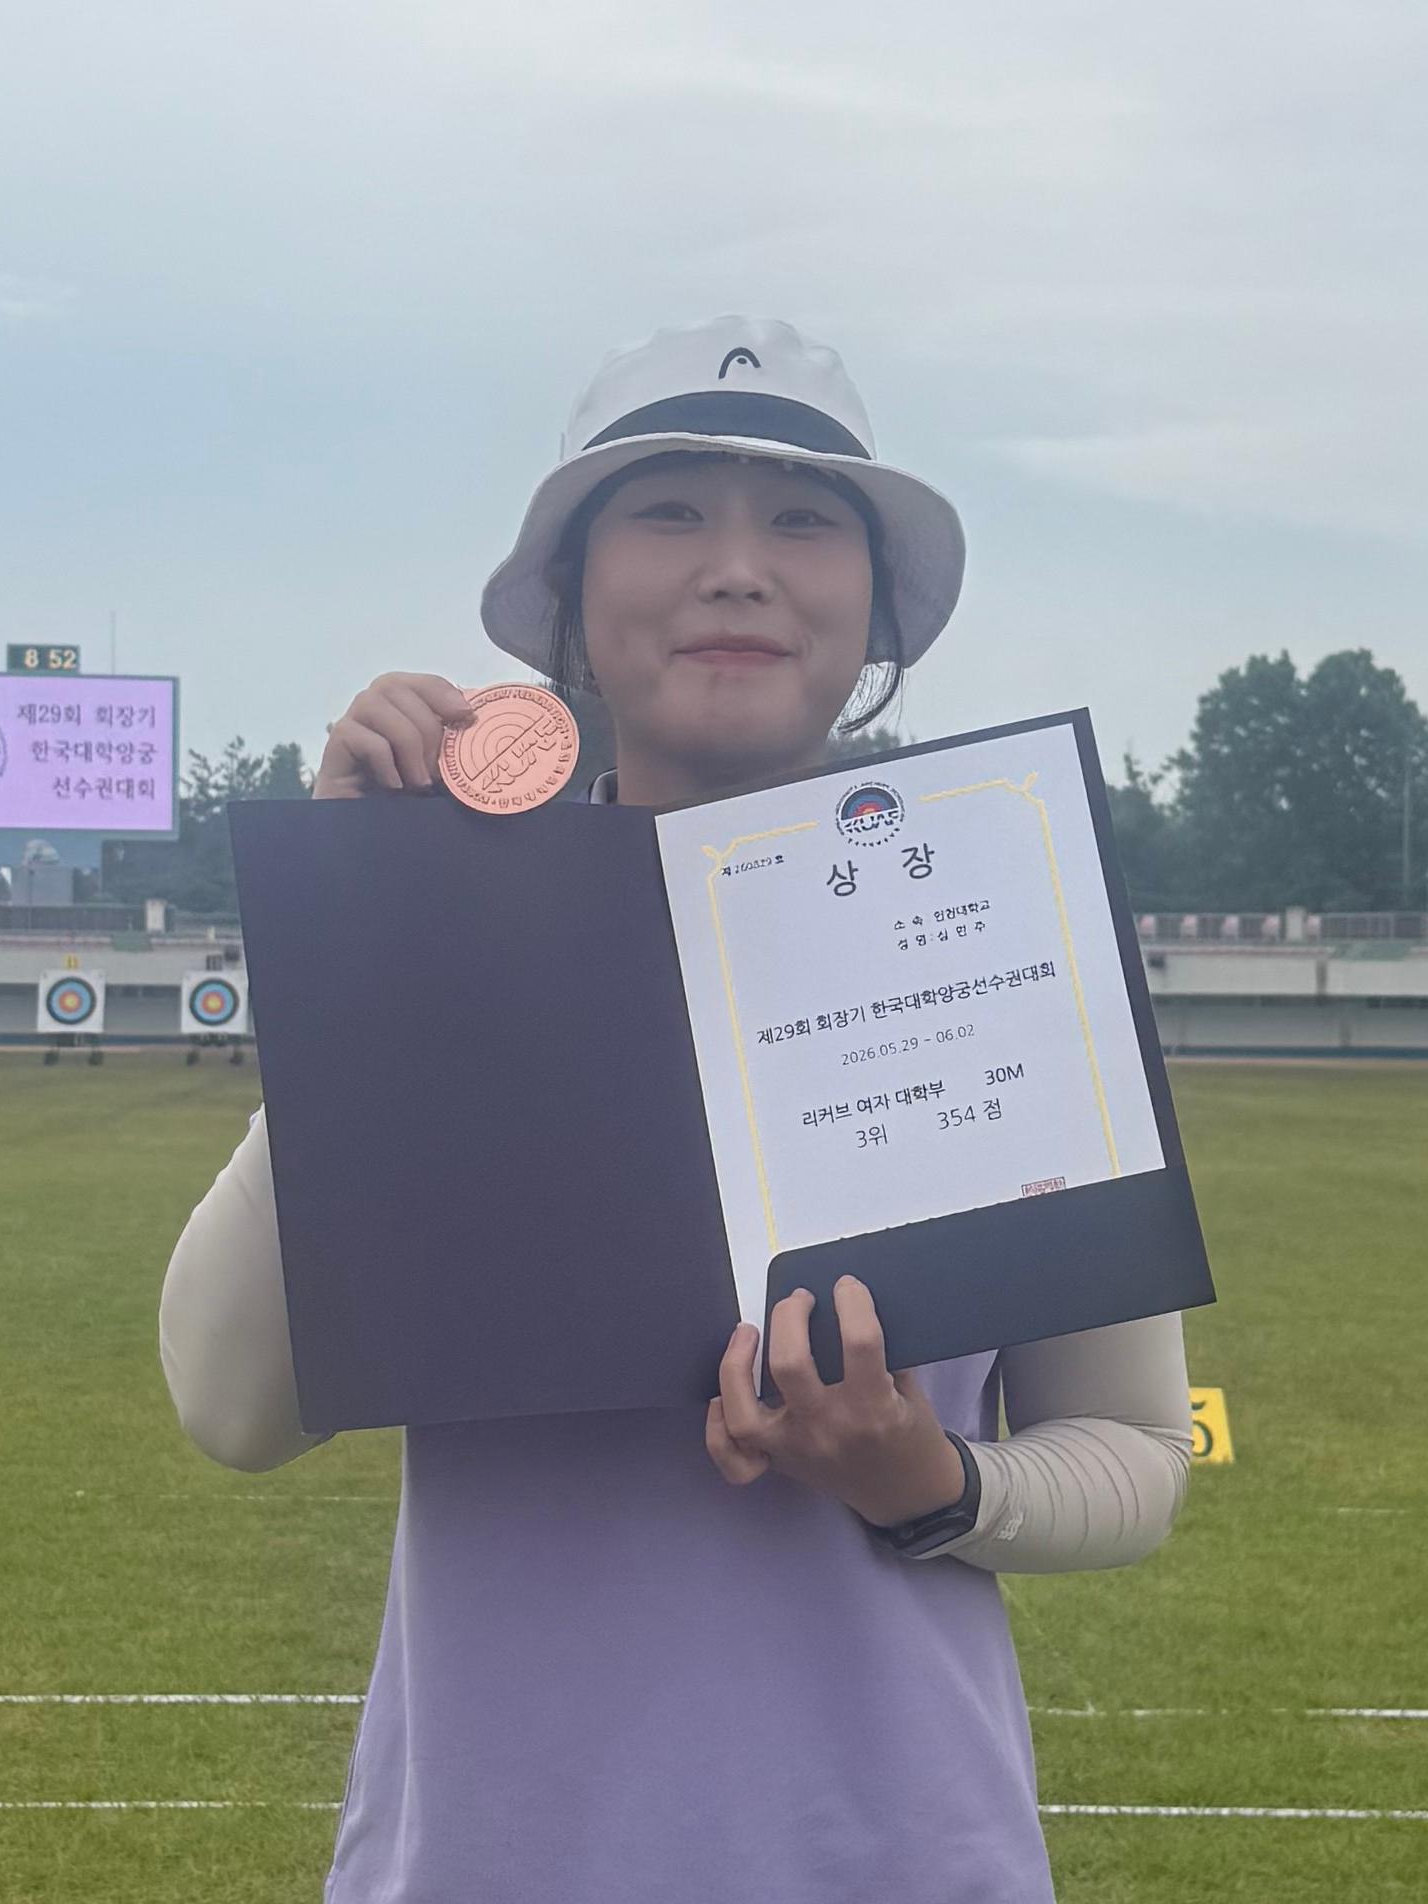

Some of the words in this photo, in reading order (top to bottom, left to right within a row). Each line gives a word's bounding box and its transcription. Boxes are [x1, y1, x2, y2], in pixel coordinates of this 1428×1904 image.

[17, 702, 82, 727] 제29회
[95, 704, 156, 729] 회장기
[31, 739, 158, 765] 한국대학양궁
[53, 775, 156, 800] 선수권대회
[756, 1018, 811, 1045] 제29회
[816, 1005, 866, 1032] 회장기
[871, 960, 1056, 1019] 한국대학양궁선수권대회
[841, 1036, 919, 1066] 2026.05.29
[936, 1024, 975, 1044] 06.02
[802, 1102, 852, 1128] 리커브
[856, 1093, 890, 1115] 여자
[895, 1080, 946, 1106] 대학부
[984, 1063, 1024, 1086] 30M
[855, 1123, 888, 1149] 3위
[937, 1105, 976, 1130] 354
[983, 1097, 1002, 1121] 점
